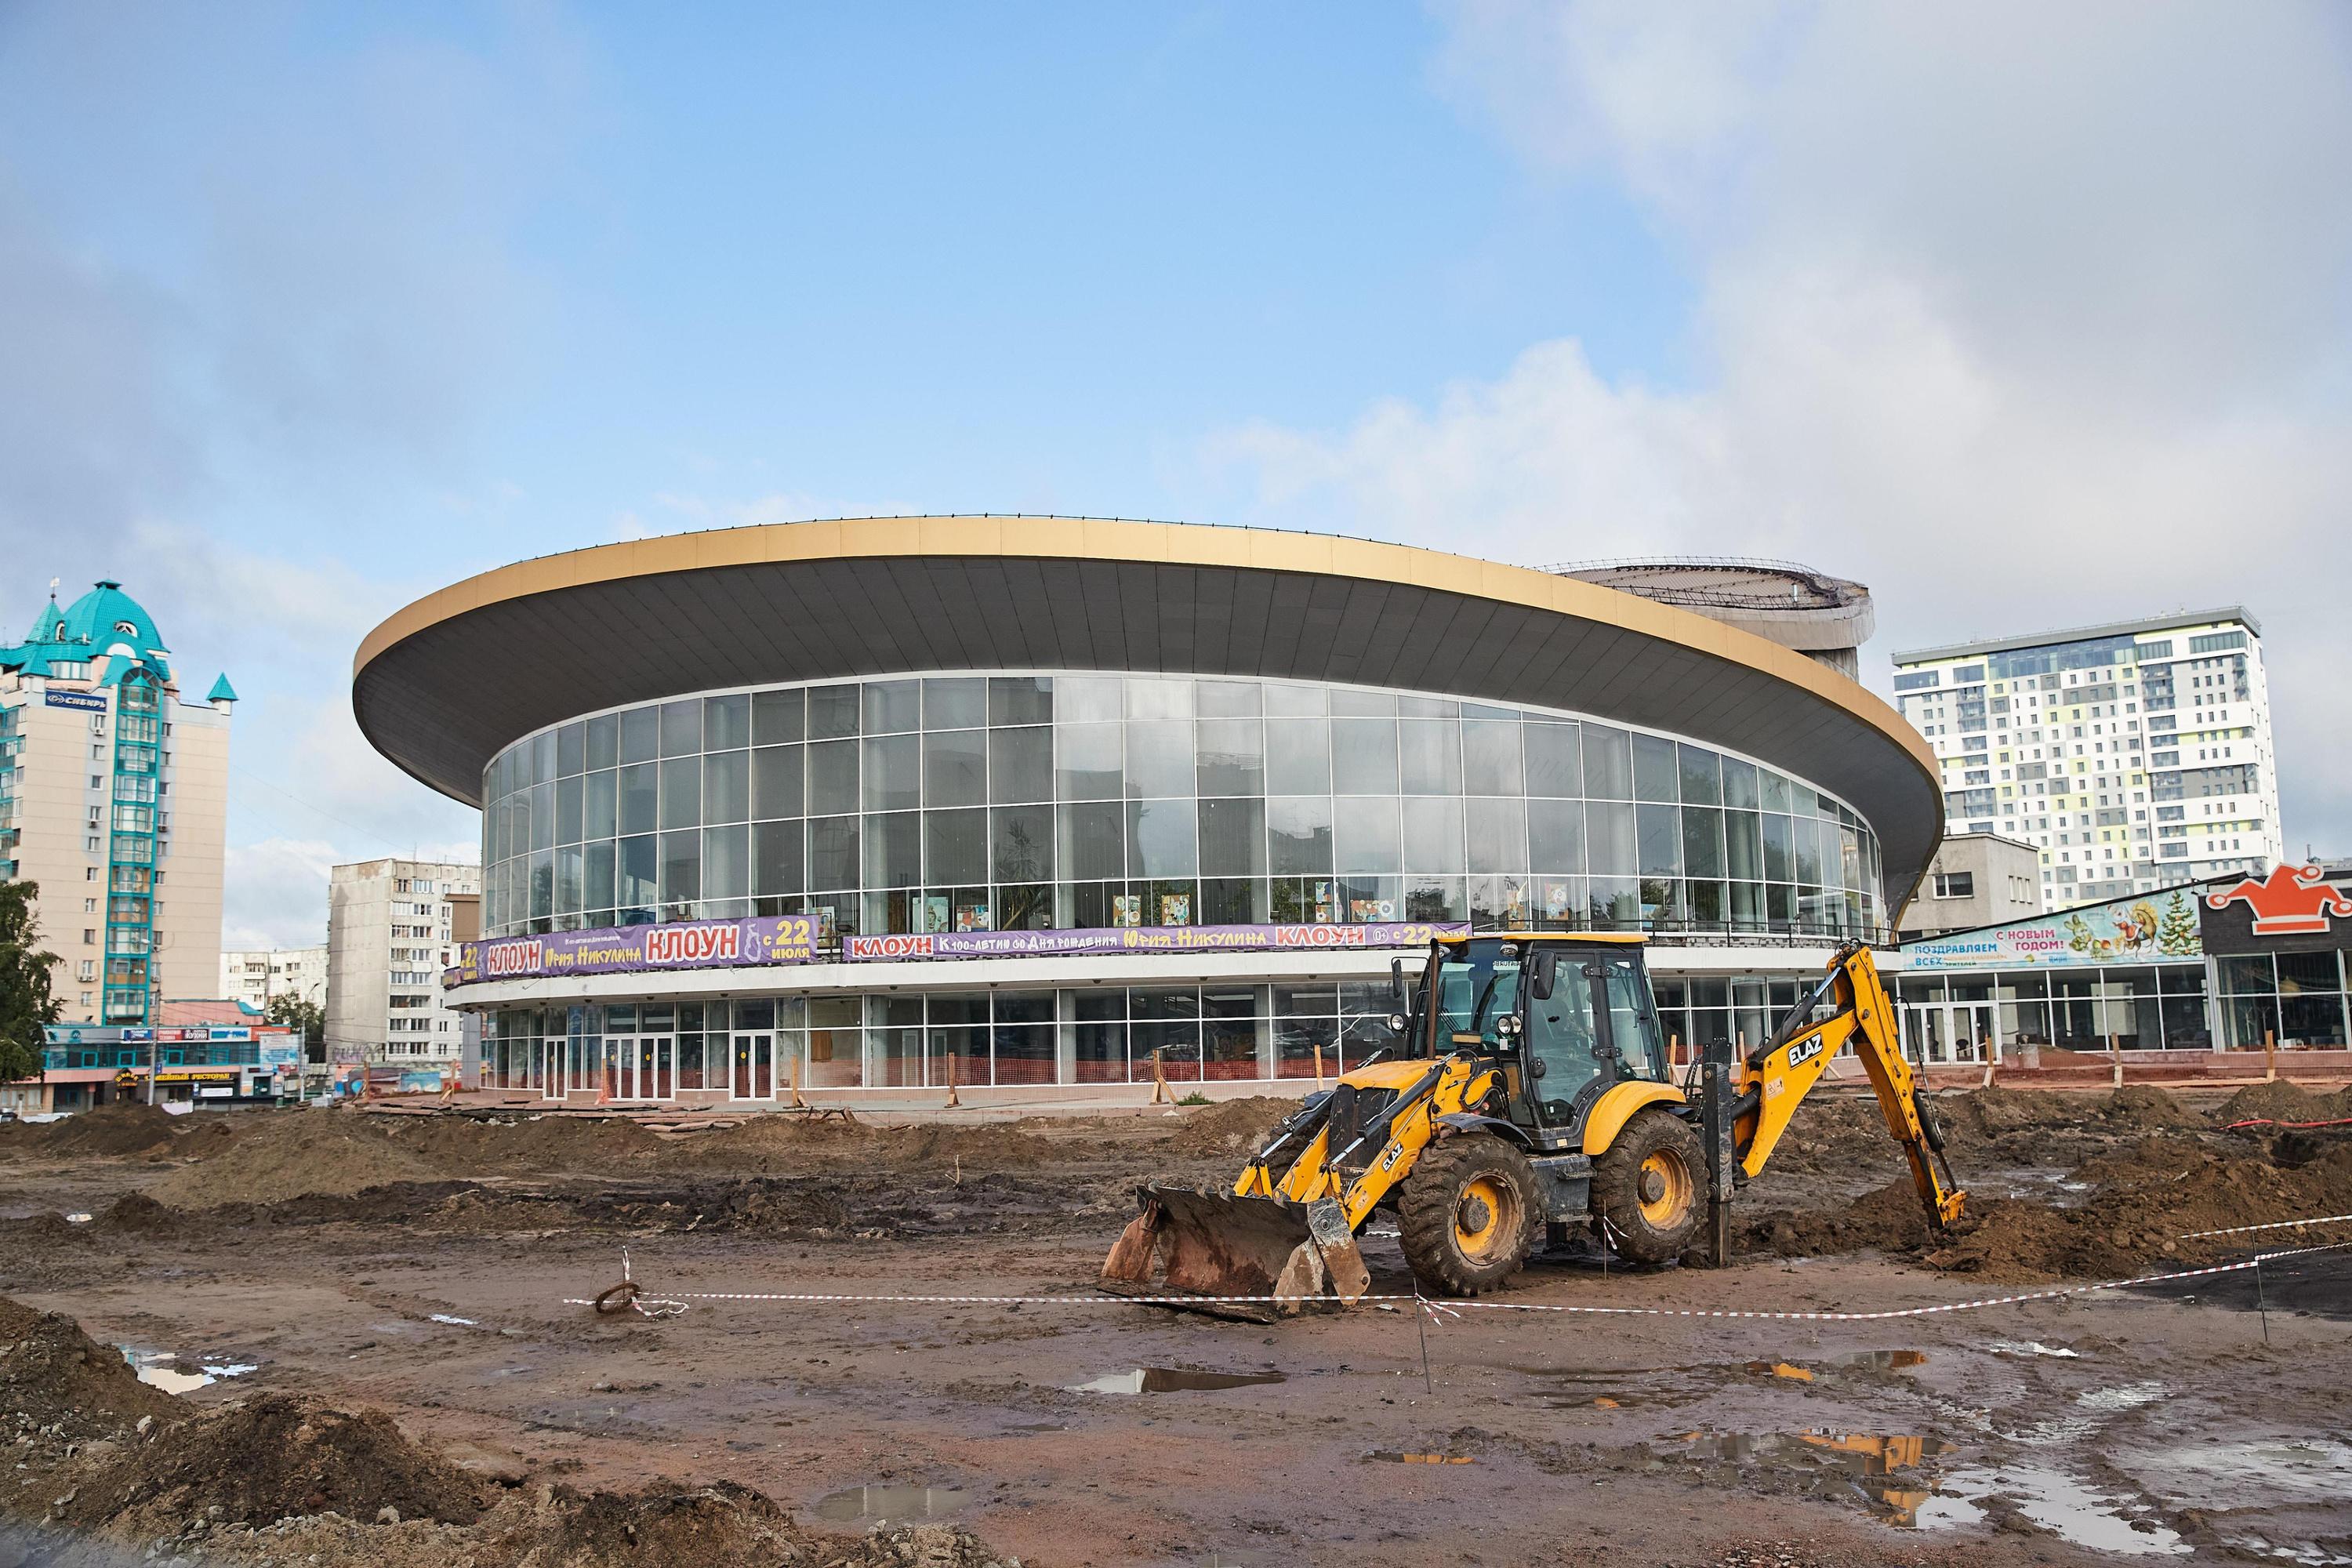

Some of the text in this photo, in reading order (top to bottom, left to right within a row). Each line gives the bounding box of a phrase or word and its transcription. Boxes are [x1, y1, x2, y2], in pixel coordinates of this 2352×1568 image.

[65, 697, 107, 708] СИБИРЬ
[776, 920, 810, 946] 22
[852, 935, 933, 957] КЛОУН
[939, 937, 949, 951] К
[951, 939, 1010, 951] 100-ЛЕТИЮ
[1027, 935, 1054, 950] ДНЯ
[1057, 936, 1118, 949] РОЖДЕНИЯ
[1123, 930, 1171, 948] ЮРИЯ
[1177, 929, 1267, 947] НИКУЛИНА
[1276, 926, 1366, 946] КЛОУН
[1376, 931, 1386, 941] 0+
[1403, 926, 1431, 945] 22
[1996, 930, 2055, 940] С НОВЫМ
[646, 925, 739, 964] КЛОУН
[771, 947, 810, 959] ИЮЛЯ
[1915, 943, 1998, 954] ПОЗДРАВЛЯЕМ
[2016, 940, 2063, 951] ГОДОМ!
[465, 946, 477, 967] 22
[488, 940, 542, 975] КЛОУН
[1915, 956, 1943, 966] ВСЕХ
[1788, 1033, 1823, 1067] ELAZ
[1382, 1142, 1403, 1171] ELAZ
